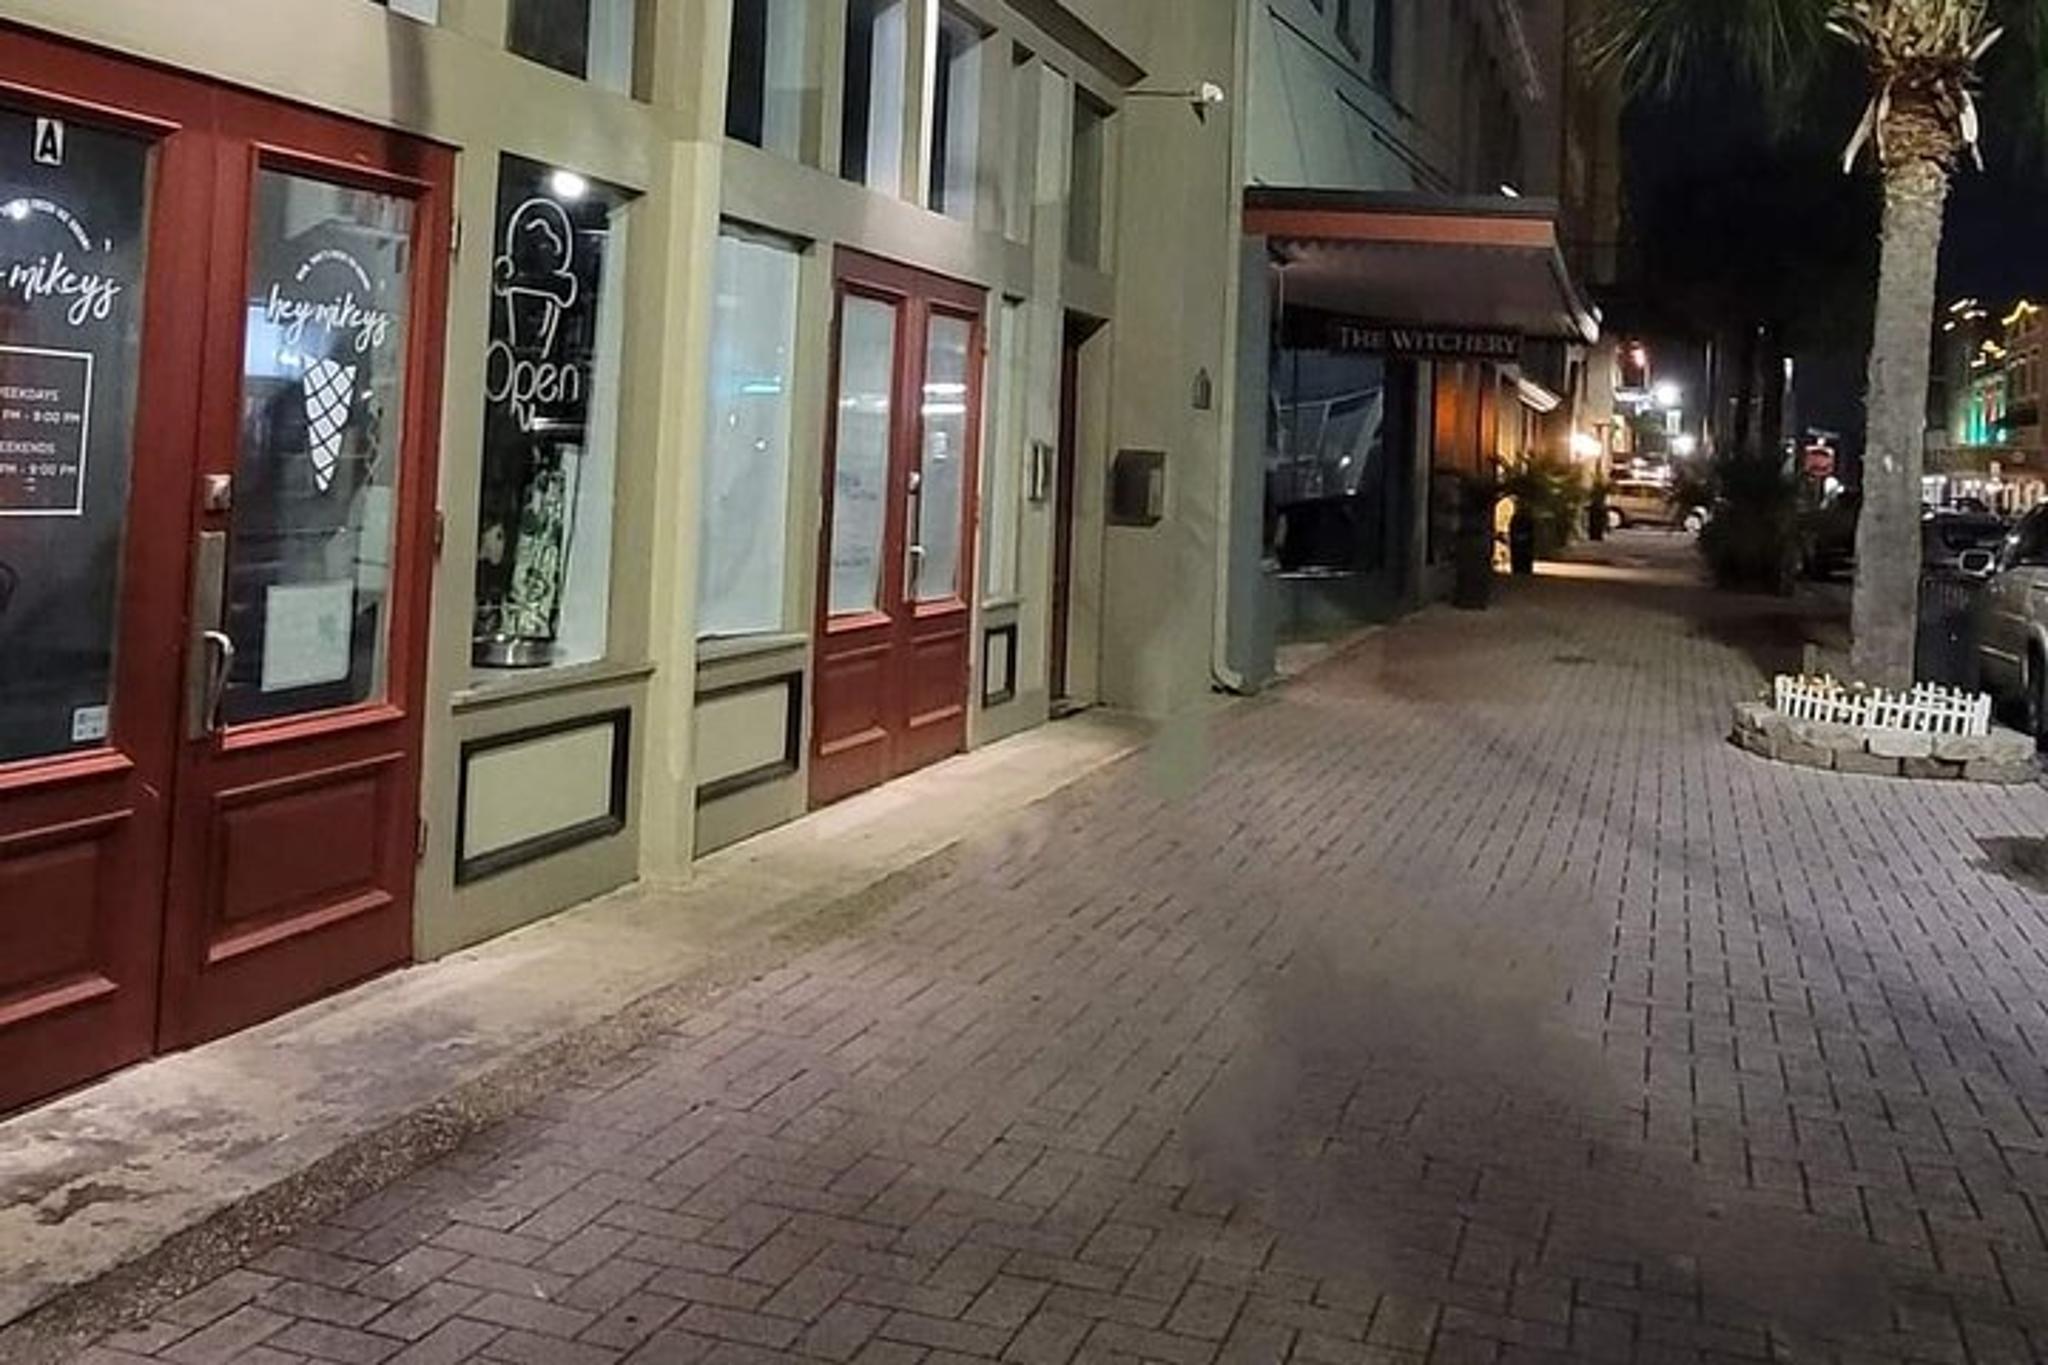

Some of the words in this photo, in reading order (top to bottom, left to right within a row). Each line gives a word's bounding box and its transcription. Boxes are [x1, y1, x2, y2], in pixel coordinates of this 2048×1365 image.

[39, 119, 59, 161] A
[1341, 326, 1383, 348] THE
[1391, 329, 1518, 354] WITCHERY
[484, 338, 578, 431] Open
